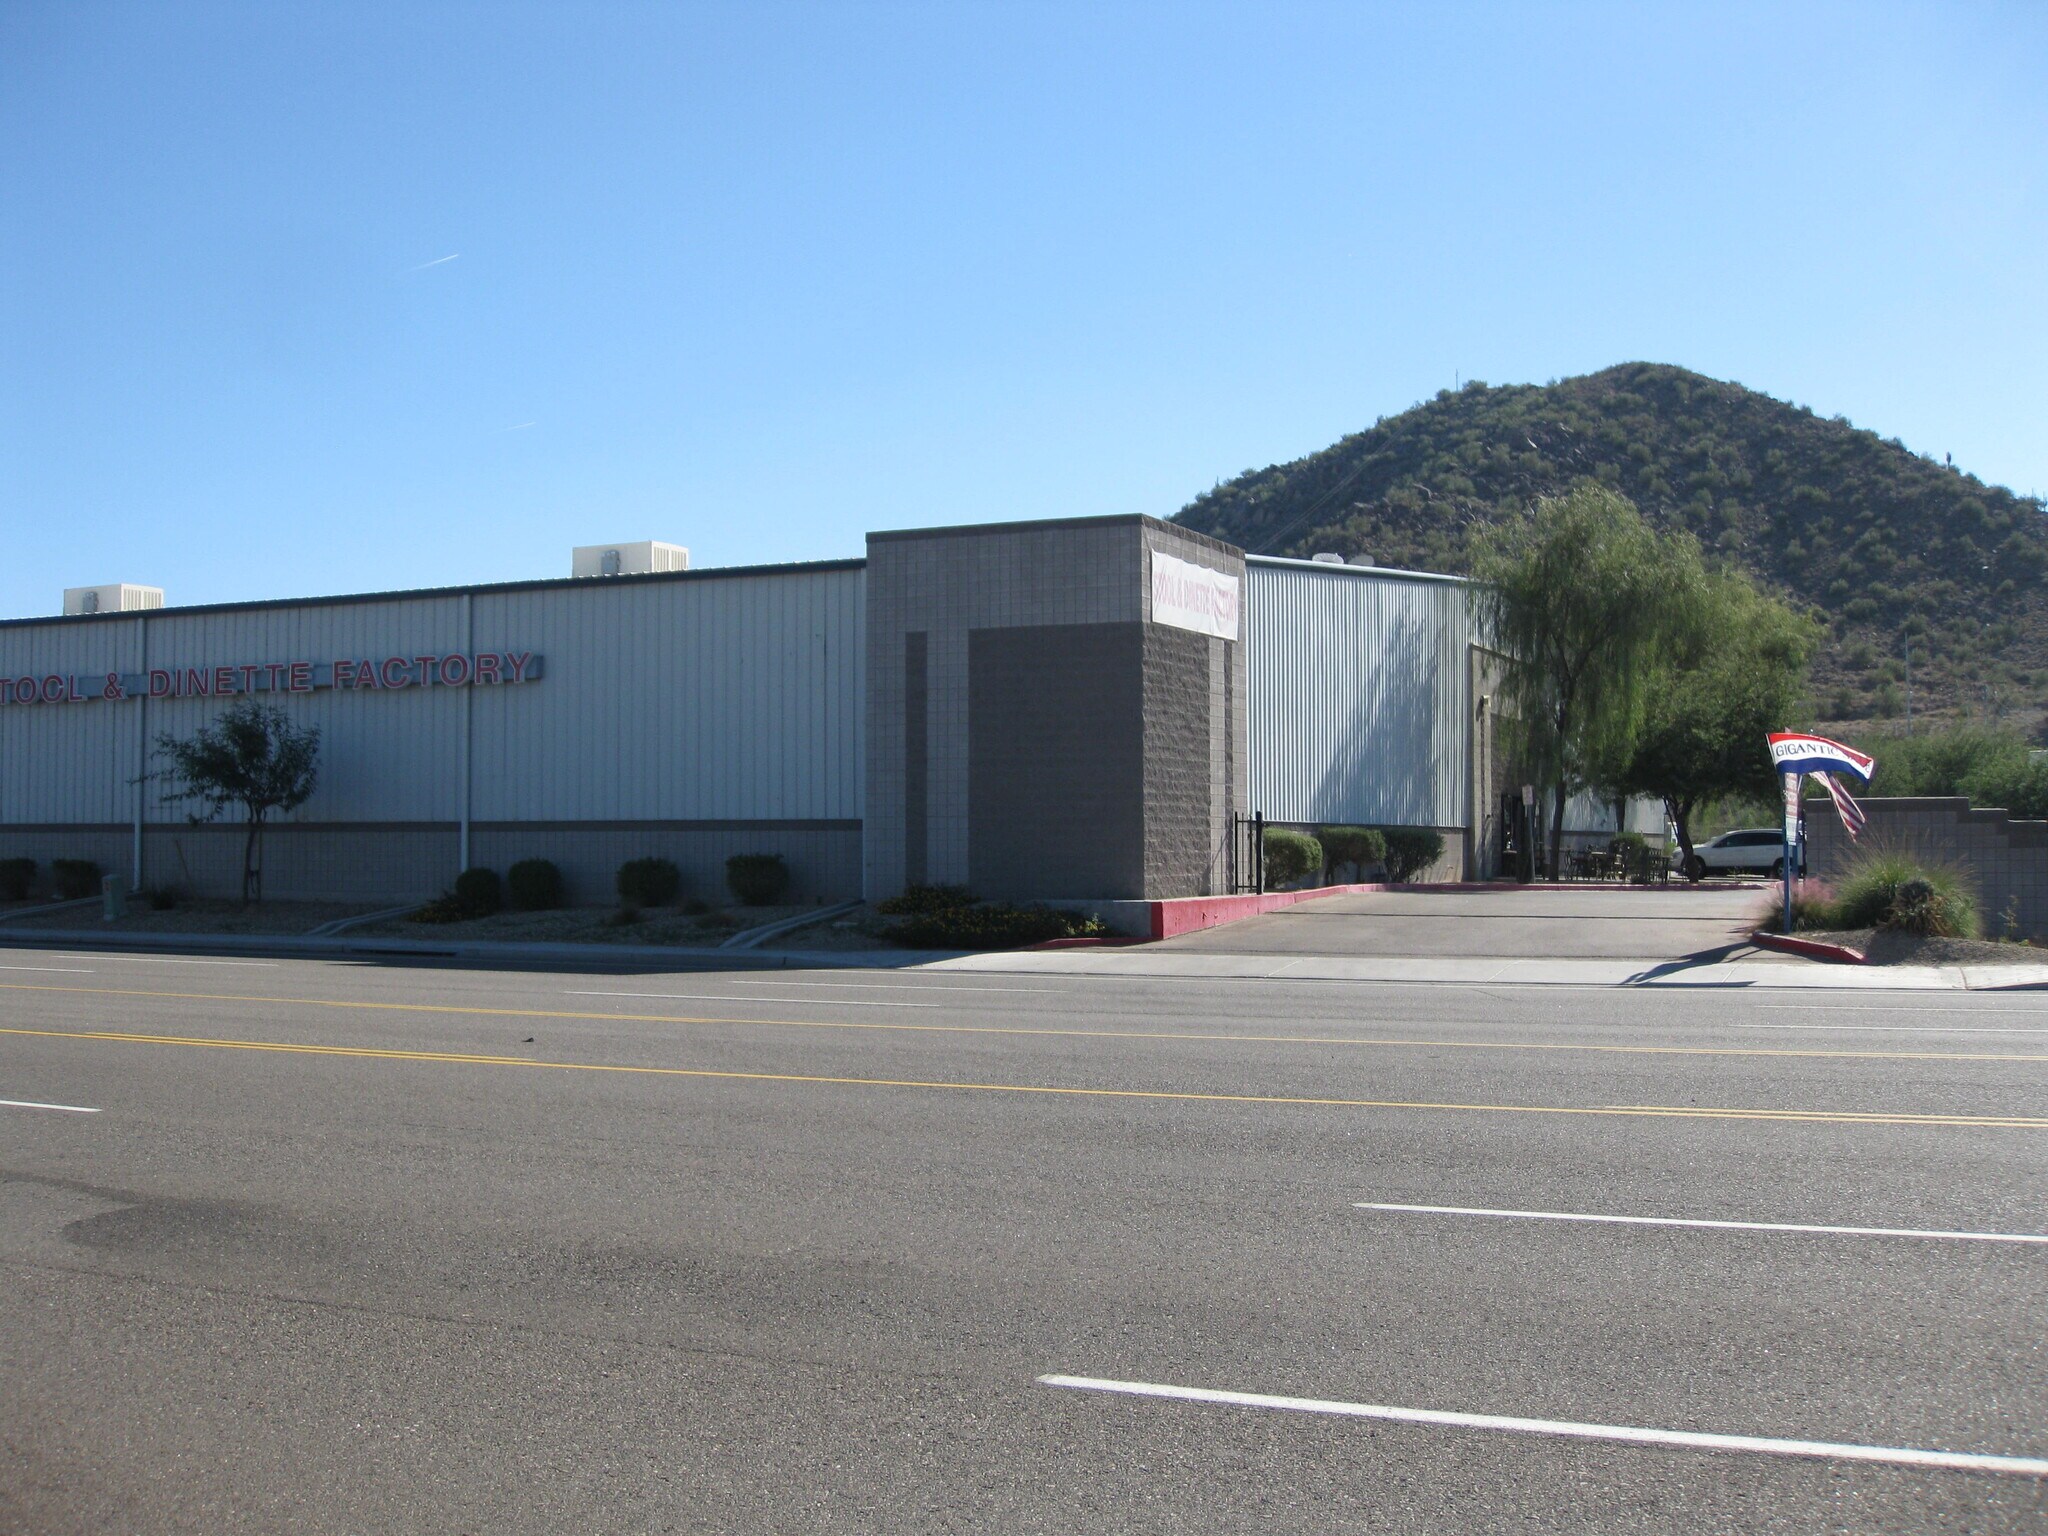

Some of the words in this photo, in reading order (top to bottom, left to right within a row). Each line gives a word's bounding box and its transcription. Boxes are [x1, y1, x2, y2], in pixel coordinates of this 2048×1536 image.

[103, 671, 124, 700] &
[149, 660, 312, 697] DINETTE
[332, 651, 532, 690] FACTORY
[1775, 743, 1838, 757] GIGANTIC
